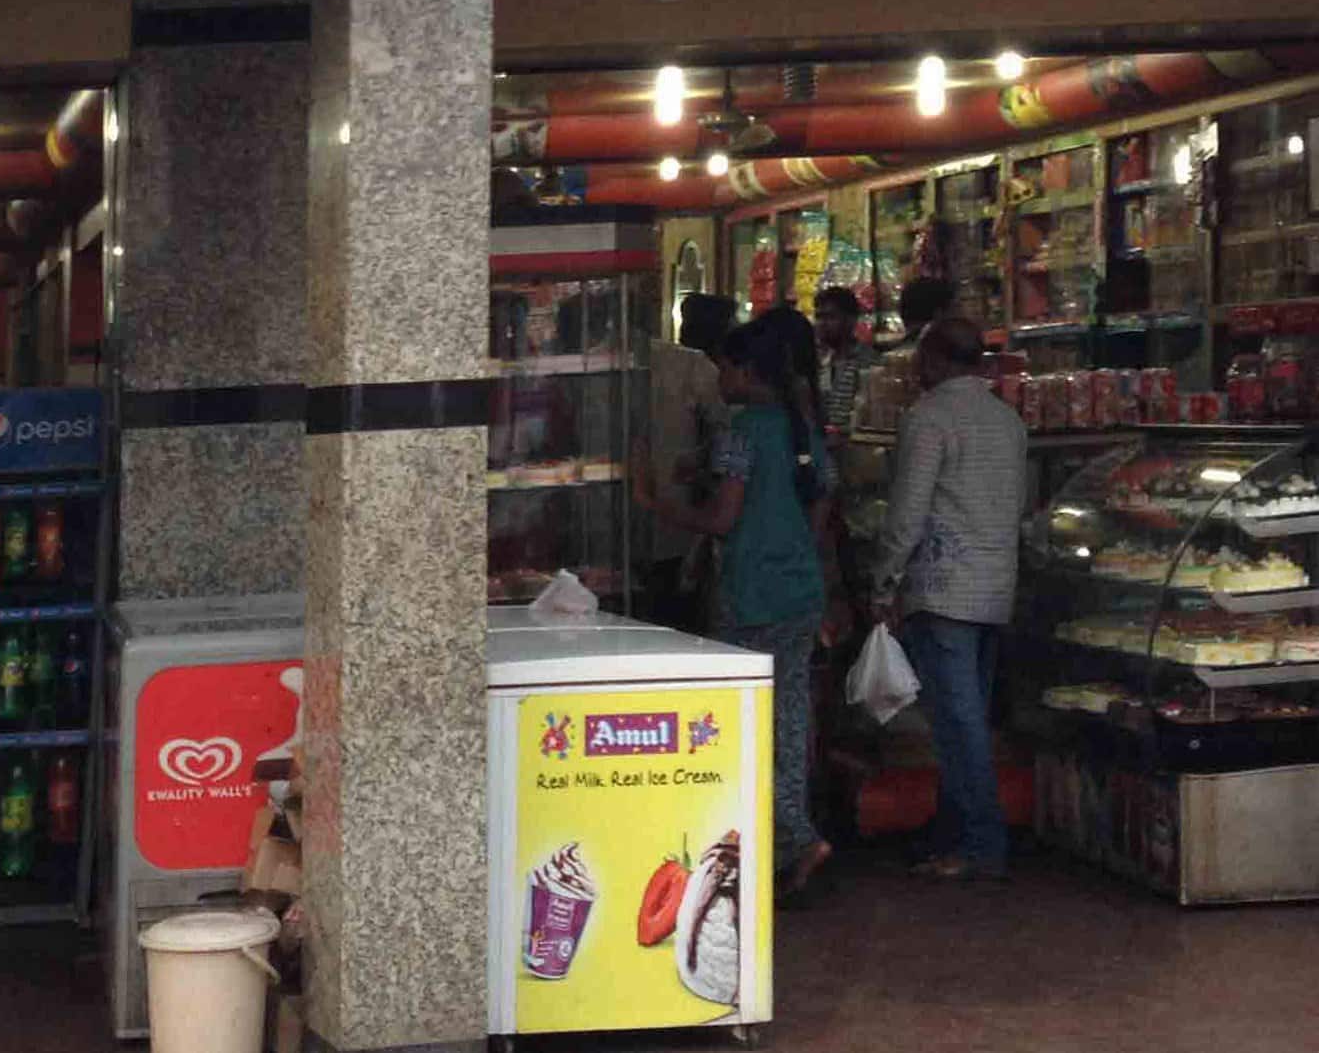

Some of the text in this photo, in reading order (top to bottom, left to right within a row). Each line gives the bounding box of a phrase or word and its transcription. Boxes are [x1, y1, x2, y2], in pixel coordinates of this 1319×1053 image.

[16, 414, 94, 444] pepsi
[591, 721, 670, 748] Amul
[536, 774, 569, 789] Real
[611, 771, 643, 787] Real
[648, 770, 668, 785] Ice
[147, 788, 205, 801] KWALITY
